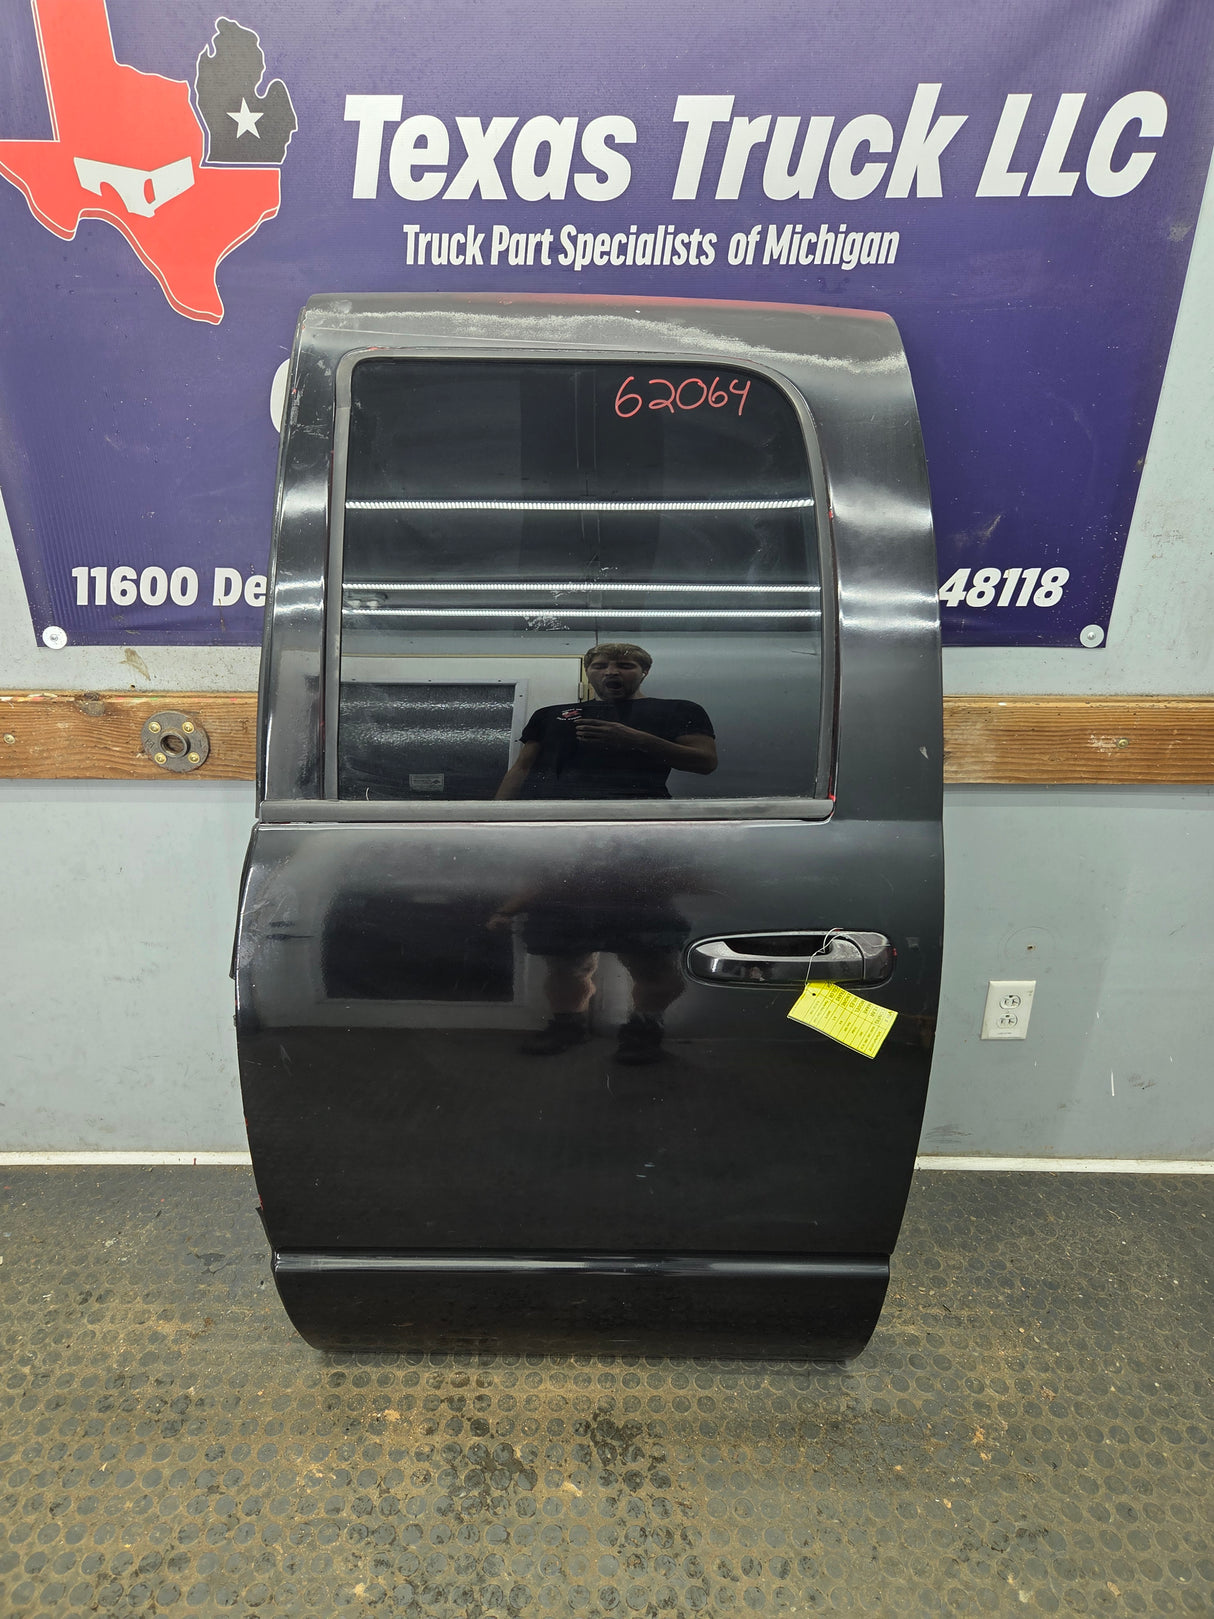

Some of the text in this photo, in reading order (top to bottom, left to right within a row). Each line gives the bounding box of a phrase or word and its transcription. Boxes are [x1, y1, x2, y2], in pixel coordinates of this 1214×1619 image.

[344, 83, 1167, 201] Texas Truck LLC
[403, 224, 899, 270] Truck Part Specialists of Michigan
[616, 377, 750, 417] 62064
[72, 567, 1069, 607] 11600 De 48118
